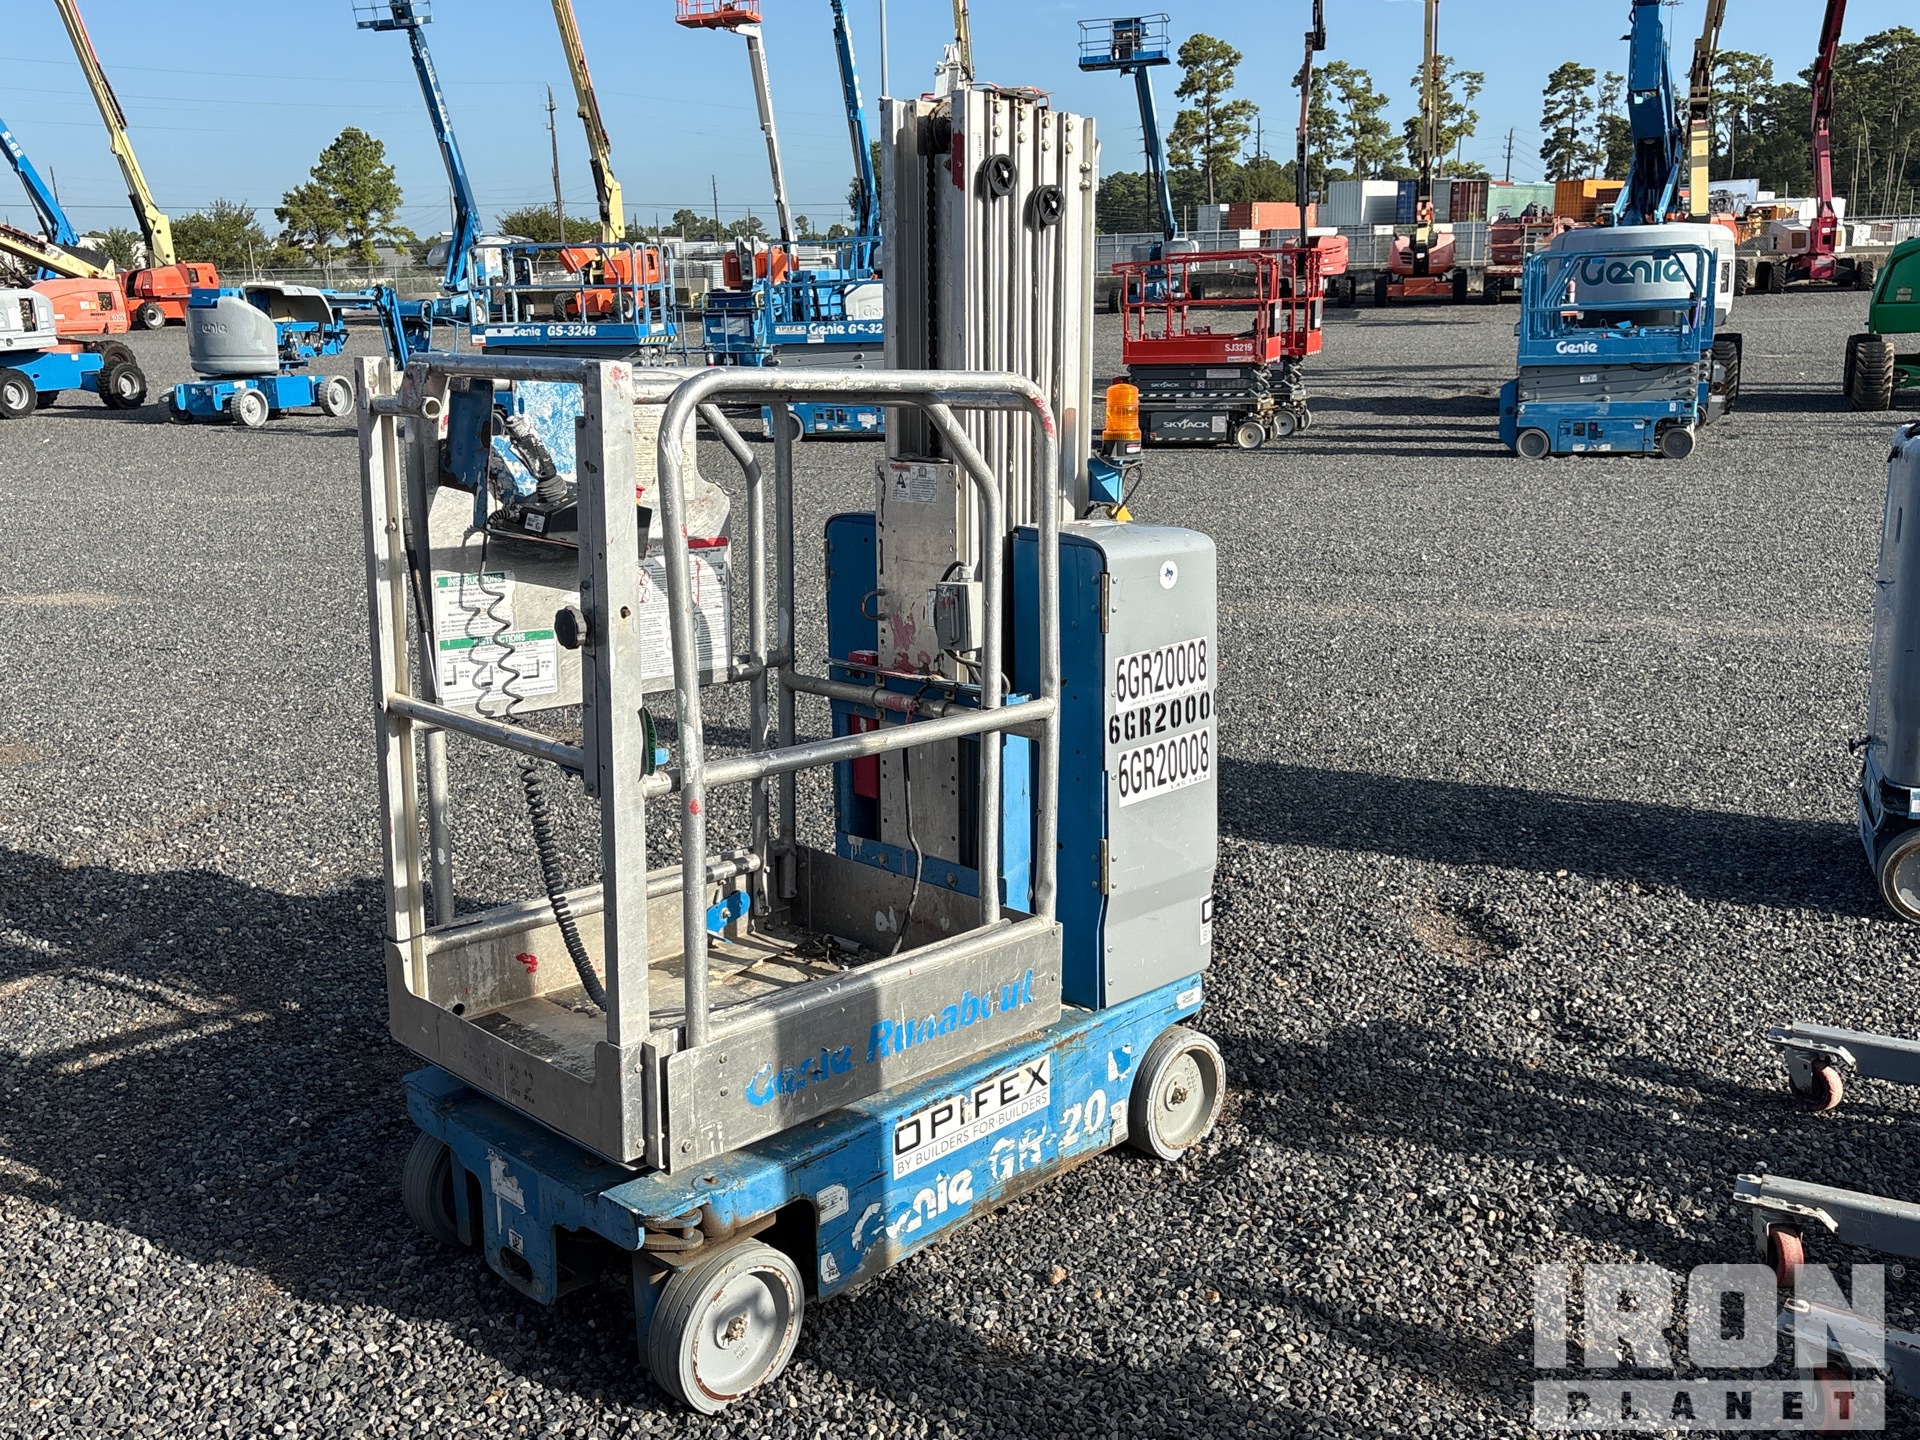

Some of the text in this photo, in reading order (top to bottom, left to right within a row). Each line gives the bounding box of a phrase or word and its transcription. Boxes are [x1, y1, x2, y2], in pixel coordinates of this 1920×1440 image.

[2, 131, 23, 158] S-65
[1580, 259, 1685, 286] Genie
[512, 325, 597, 337] Genie GS-3246
[808, 323, 884, 335] Genie GS-32
[1224, 342, 1253, 352] SJ3219
[1556, 341, 1598, 354] Genie
[1162, 418, 1210, 430] SKYJACK
[1116, 638, 1207, 703] 6GR20008
[1119, 729, 1210, 798] 6GR20008
[894, 1058, 1049, 1156] OPIFEX
[896, 1091, 1048, 1175] BY BUILDERS FOR BUILDERS
